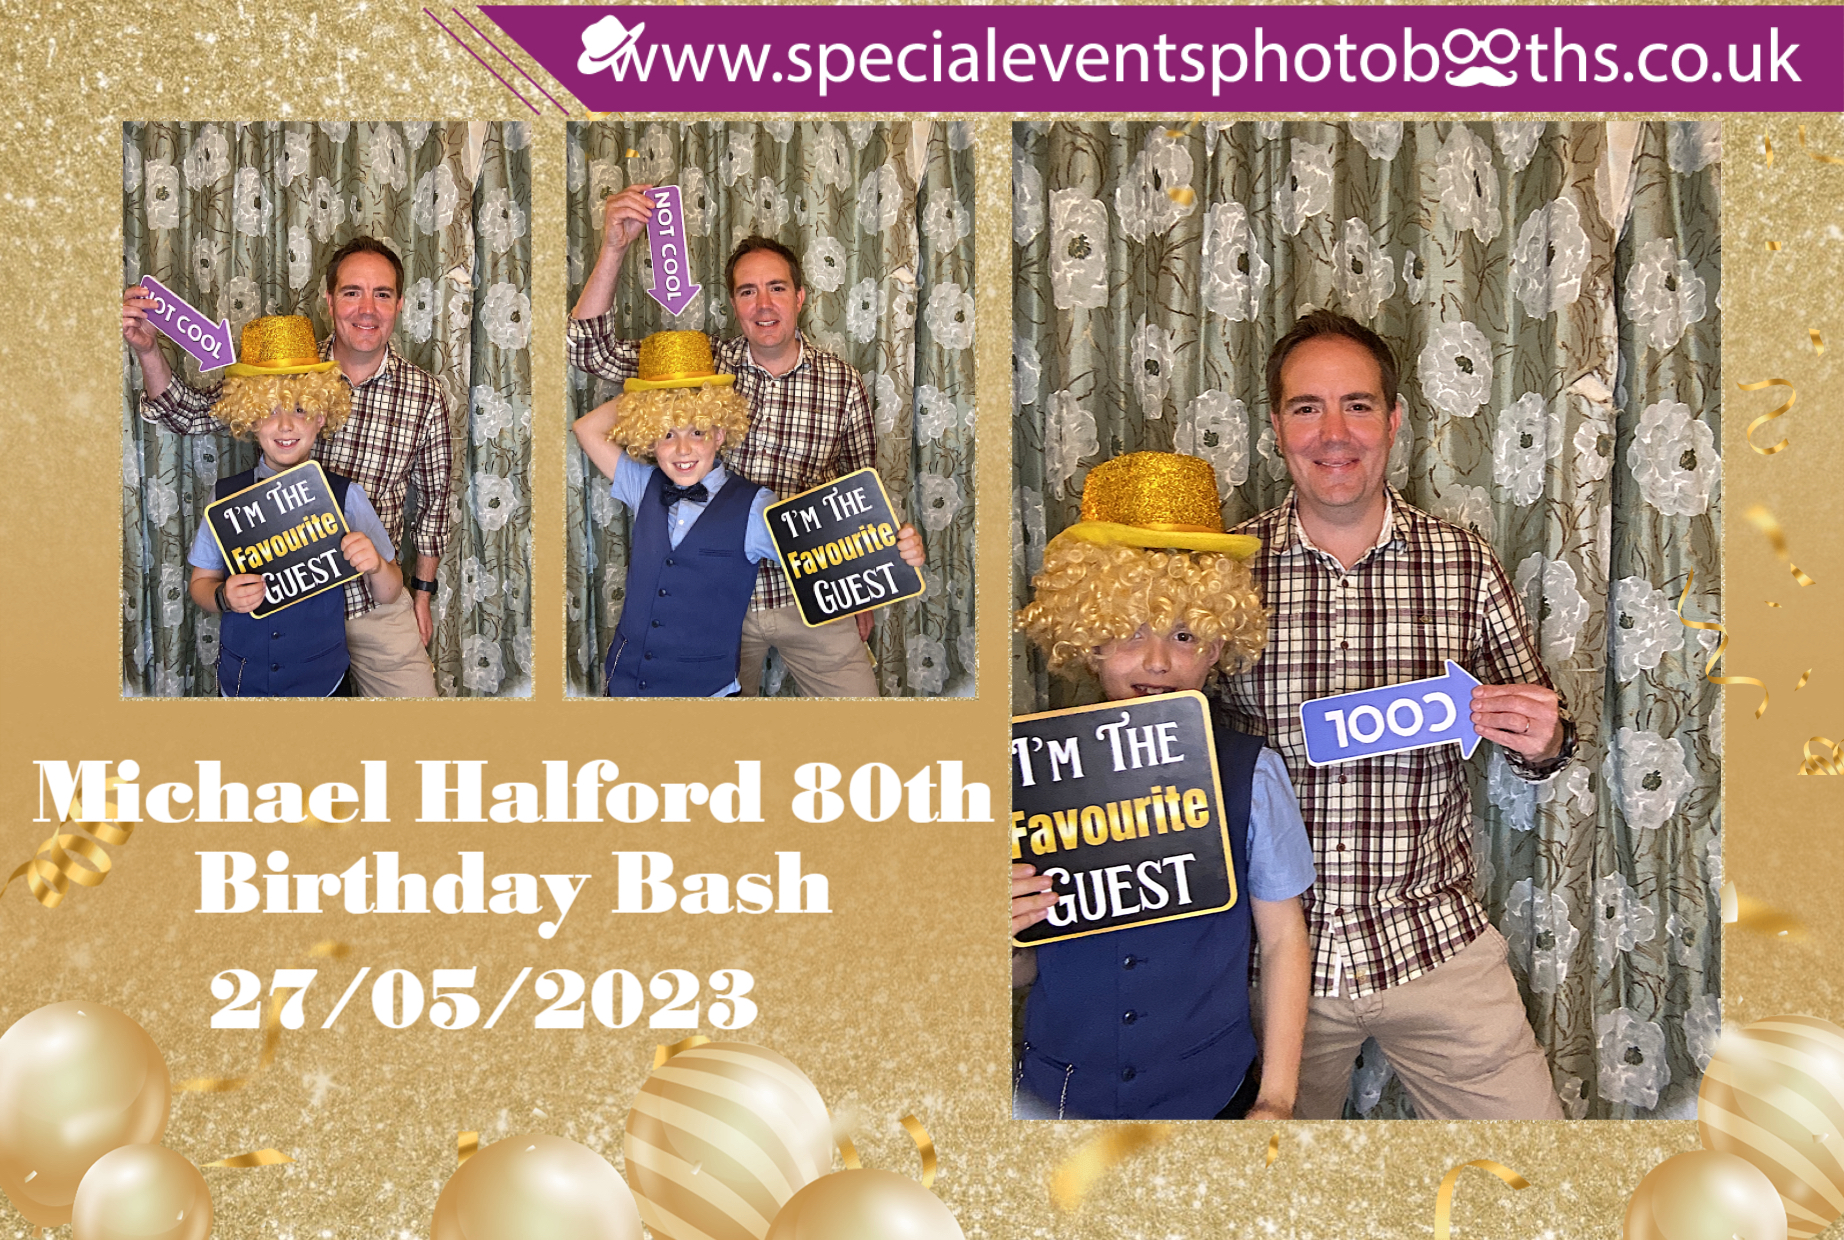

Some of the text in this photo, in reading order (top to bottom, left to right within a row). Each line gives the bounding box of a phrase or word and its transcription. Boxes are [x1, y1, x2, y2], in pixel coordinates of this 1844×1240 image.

[654, 191, 682, 302] NOT COOL
[176, 315, 223, 360] COOL
[223, 480, 317, 535] I'M THE
[780, 486, 874, 540] I'M THE
[231, 511, 339, 575] Favourite
[787, 522, 898, 580] Favourite
[263, 548, 343, 606] GUEST
[812, 562, 900, 616] GUEST
[1012, 711, 1185, 787] I'M THE
[1324, 691, 1457, 749] COOL
[1012, 785, 1210, 860] Favourite
[1041, 852, 1197, 927] GUEST
